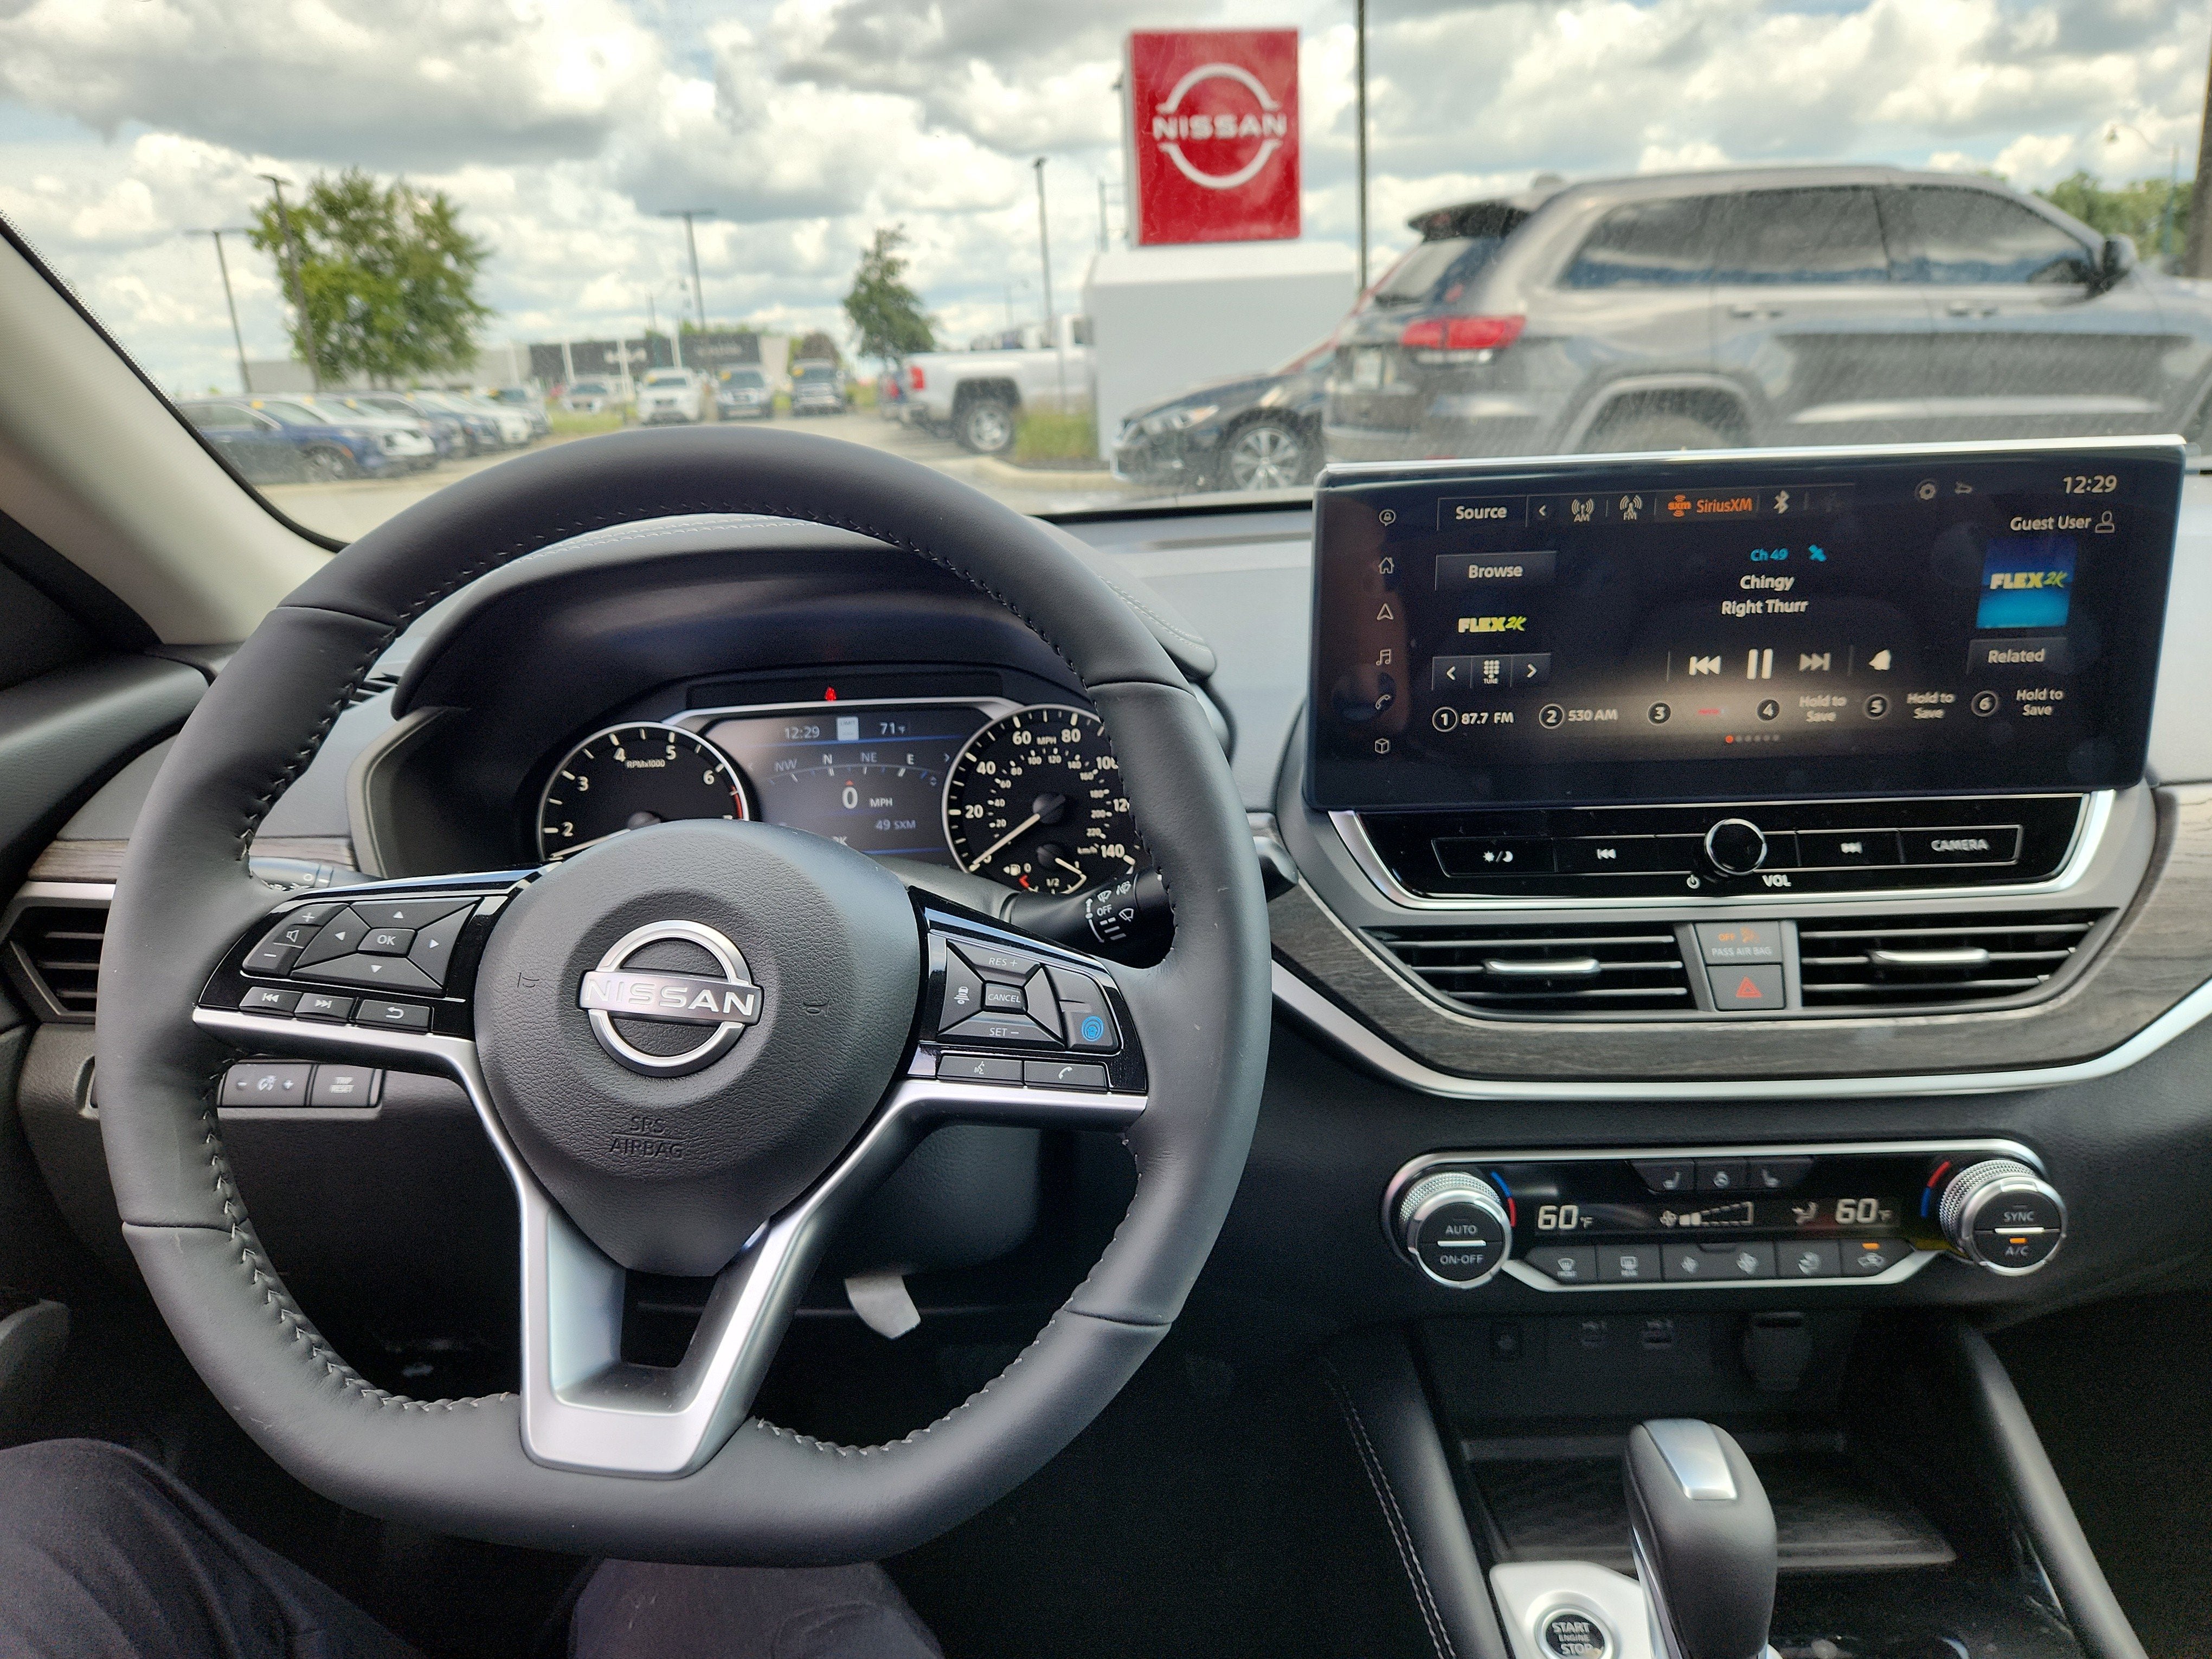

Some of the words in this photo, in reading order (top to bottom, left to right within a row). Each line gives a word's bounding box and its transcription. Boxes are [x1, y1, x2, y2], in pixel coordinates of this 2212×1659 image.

[1152, 113, 1287, 141] NISSAN
[2063, 475, 2117, 494] 12:29
[1696, 498, 1753, 513] SiriusXM
[1456, 505, 1507, 520] Source
[1623, 512, 1637, 520] FM
[2010, 516, 2054, 531] Guest
[2057, 515, 2092, 530] User
[1750, 549, 1769, 561] Ch
[1770, 548, 1789, 561] 49
[1469, 564, 1523, 579] Browse
[1740, 575, 1795, 591] Chingy
[1721, 599, 1764, 618] Right
[1765, 598, 1809, 613] Thurr
[1988, 648, 2045, 664] Related
[1906, 692, 1939, 704] Hold
[1940, 692, 1956, 704] to
[2016, 688, 2048, 701] Hold
[2049, 689, 2063, 700] to
[1762, 703, 1774, 717] 4
[1798, 695, 1830, 708] Hold
[1831, 696, 1848, 707] to
[2022, 704, 2053, 716] Save
[1441, 713, 1449, 726] 1
[1461, 712, 1489, 725] 87.7
[1494, 711, 1514, 724] FM
[1546, 710, 1558, 724] 2
[1567, 709, 1593, 722] 530
[1593, 709, 1618, 721] AM
[1654, 706, 1666, 720] 3
[1805, 710, 1837, 723] Save
[1913, 707, 1945, 719] Save
[785, 725, 820, 739] 12:29
[1012, 731, 1031, 744] 60
[1061, 729, 1081, 743] 80
[1036, 736, 1057, 745] MPH
[613, 747, 626, 762] 4
[665, 745, 677, 760] 5
[861, 752, 877, 763] NE
[774, 758, 797, 771] NW
[822, 754, 832, 765] N
[906, 753, 914, 766] E
[1027, 756, 1042, 765] 100
[1047, 755, 1062, 764] 120
[976, 761, 996, 775] 40
[577, 776, 589, 792] 3
[703, 770, 715, 785] 6
[842, 787, 858, 809] 0
[869, 798, 892, 807] MPH
[994, 799, 1005, 807] 40
[1113, 798, 1130, 812] 12
[965, 805, 983, 819] 20
[561, 821, 574, 837] 2
[876, 819, 891, 831] 49
[895, 820, 916, 829] SXM
[995, 819, 1007, 828] 20
[1101, 844, 1125, 858] 140
[1931, 839, 1989, 852] CAMERA
[1024, 863, 1031, 873] 0
[1046, 878, 1059, 887] 1/2
[1762, 874, 1791, 888] VOL
[1097, 904, 1112, 916] OFF
[377, 935, 396, 946] OK
[1718, 933, 1735, 942] OFF
[1712, 947, 1734, 956] PASS
[1736, 947, 1752, 955] AIR
[1753, 946, 1773, 956] BAG
[989, 957, 1007, 966] RES
[586, 979, 754, 1015] NISSAN
[988, 993, 1021, 1004] CANCEL
[989, 1028, 1007, 1037] SET
[630, 1116, 666, 1134] SRS
[609, 1138, 683, 1159] AIRBAG
[2004, 1212, 2035, 1223] SYNC
[1445, 1225, 1477, 1235] AUTO
[2005, 1246, 2029, 1256] A/C
[1439, 1254, 1484, 1265] ON-OFF
[1552, 1622, 1590, 1633] START
[1561, 1643, 1594, 1655] STOP
